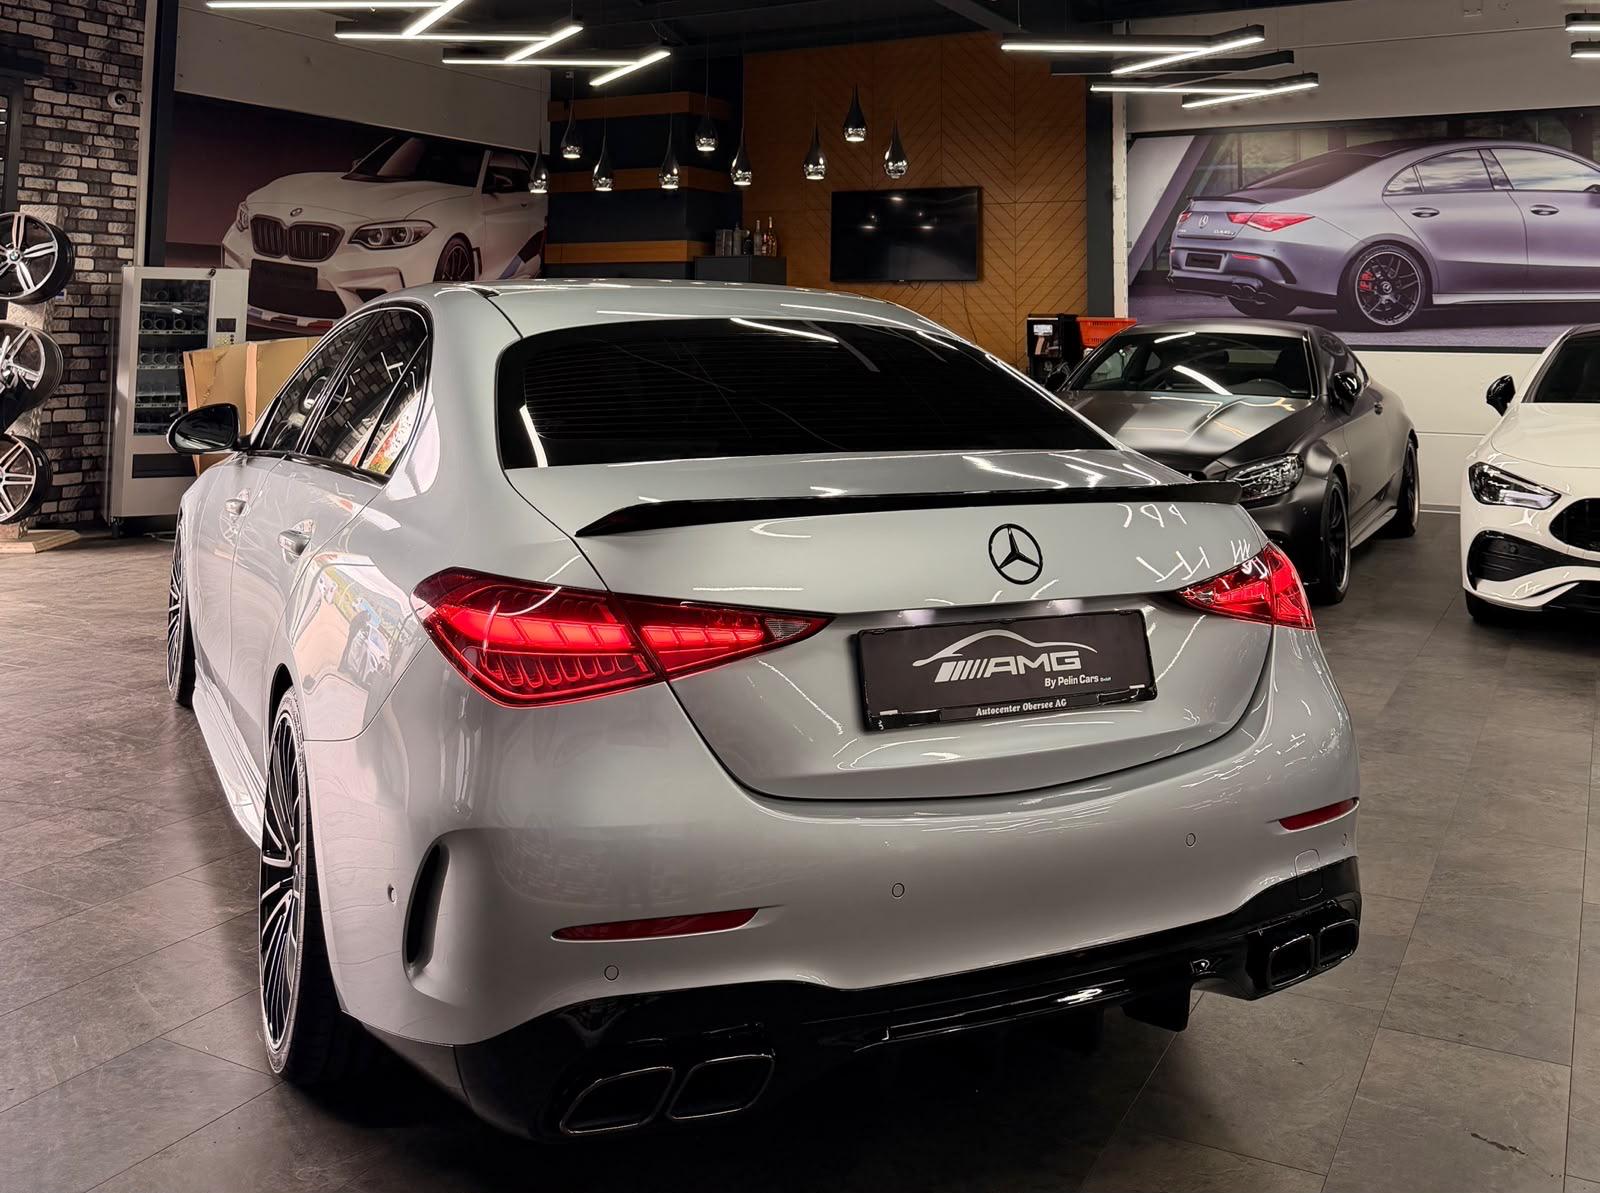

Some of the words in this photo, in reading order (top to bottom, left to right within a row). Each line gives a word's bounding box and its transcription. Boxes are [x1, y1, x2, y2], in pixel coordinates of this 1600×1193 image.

[1045, 678, 1056, 689] By
[1058, 675, 1078, 686] Pelin
[1079, 674, 1099, 684] Cars
[976, 704, 1021, 717] Autocenter
[1023, 701, 1053, 711] Obersee
[1055, 698, 1067, 707] AG
